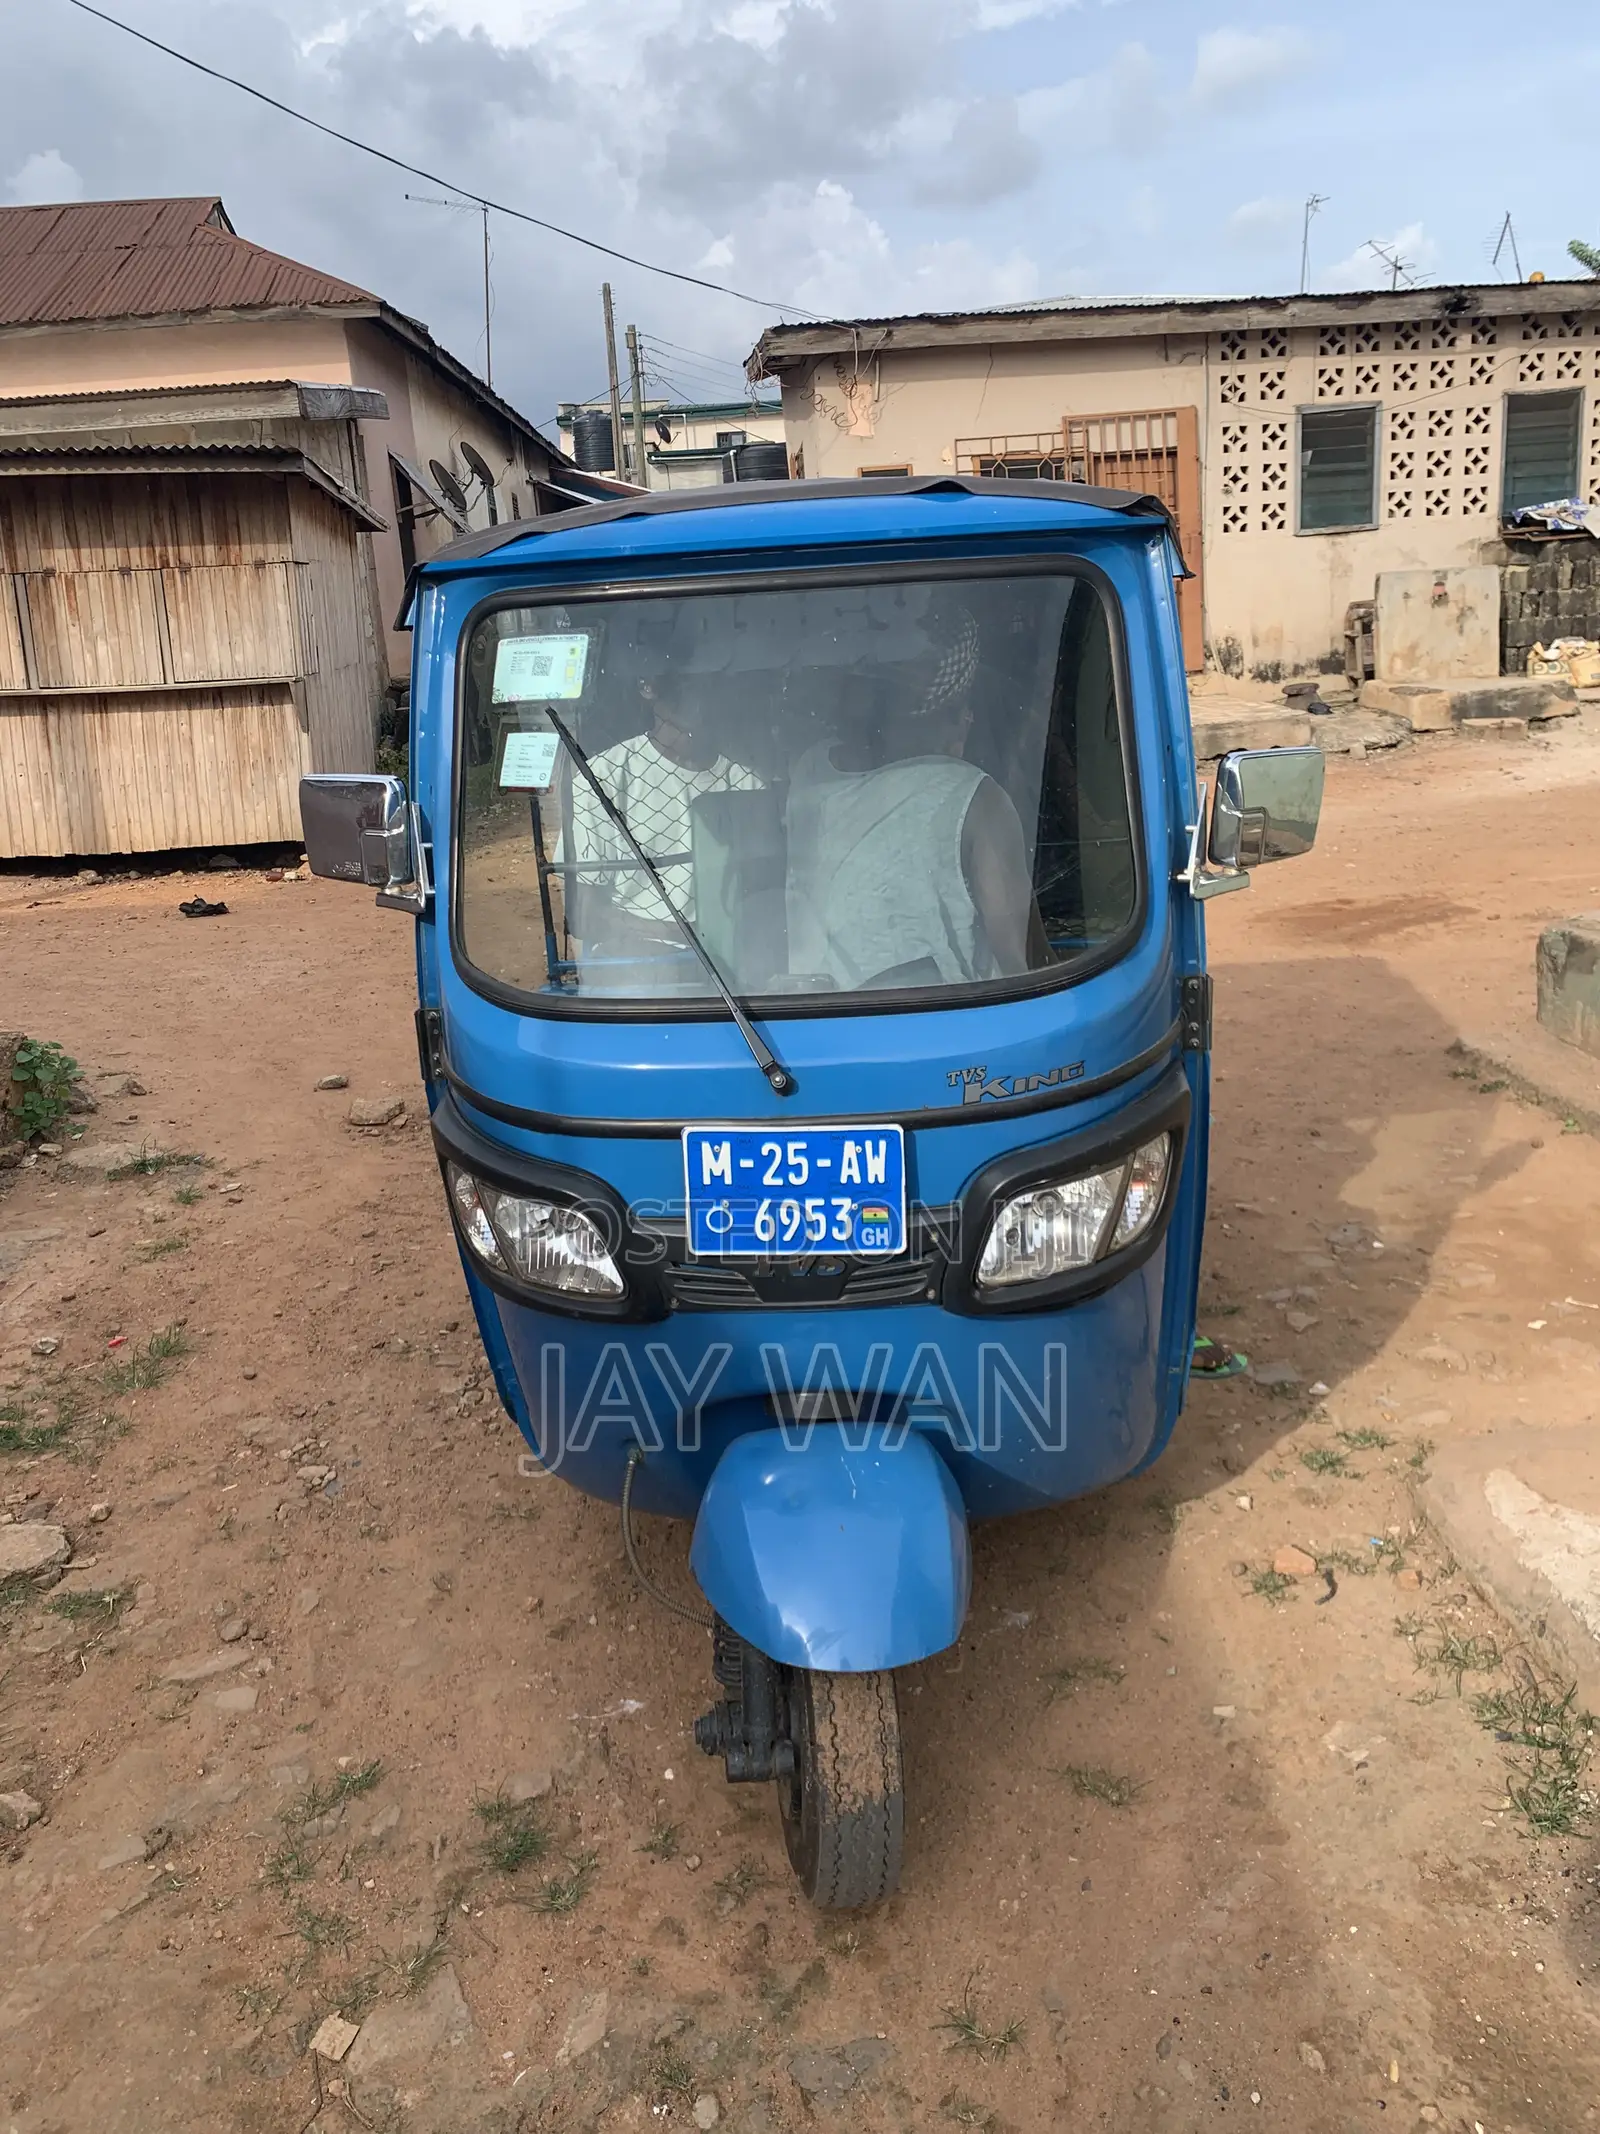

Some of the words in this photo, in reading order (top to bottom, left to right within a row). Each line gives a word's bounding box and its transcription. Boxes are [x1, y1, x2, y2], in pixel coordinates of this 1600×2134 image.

[947, 1066, 987, 1086] TVS
[963, 1060, 1086, 1105] KING
[701, 1140, 887, 1186] M-25-AW
[754, 1198, 852, 1242] 6953
[861, 1227, 890, 1246] GH
